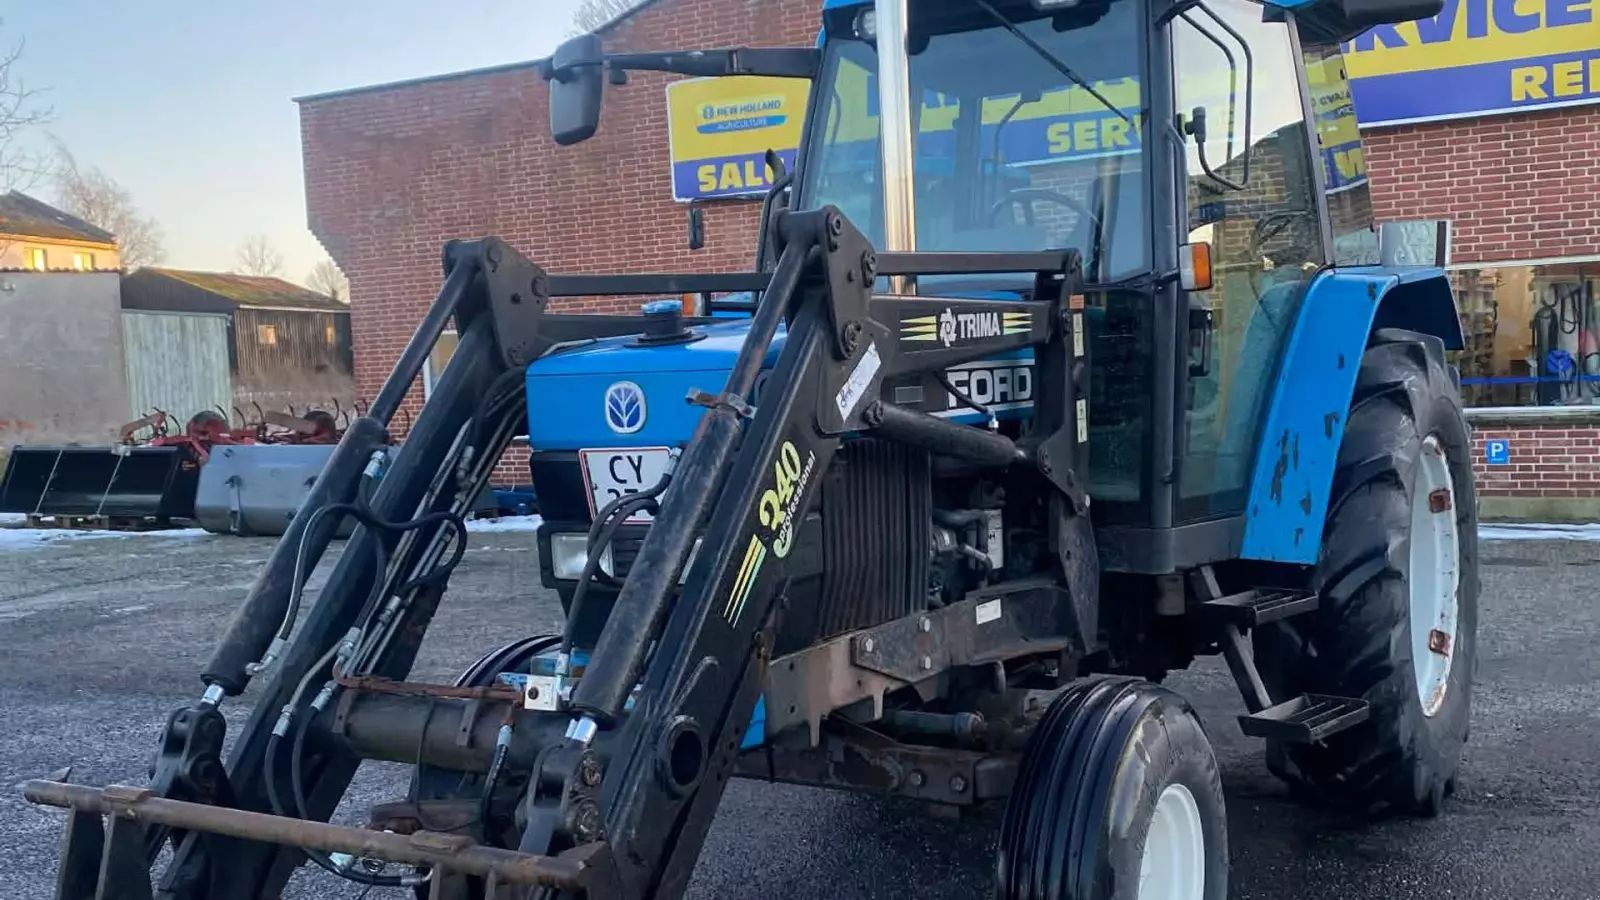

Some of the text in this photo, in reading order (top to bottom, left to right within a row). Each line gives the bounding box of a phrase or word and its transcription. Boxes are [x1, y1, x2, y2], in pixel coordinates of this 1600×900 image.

[716, 99, 782, 116] NEW HOLLAND
[957, 312, 1001, 339] TRIMA
[947, 367, 1032, 408] FORD
[1491, 442, 1504, 457] P
[609, 455, 643, 484] CY
[760, 441, 801, 531] 240
